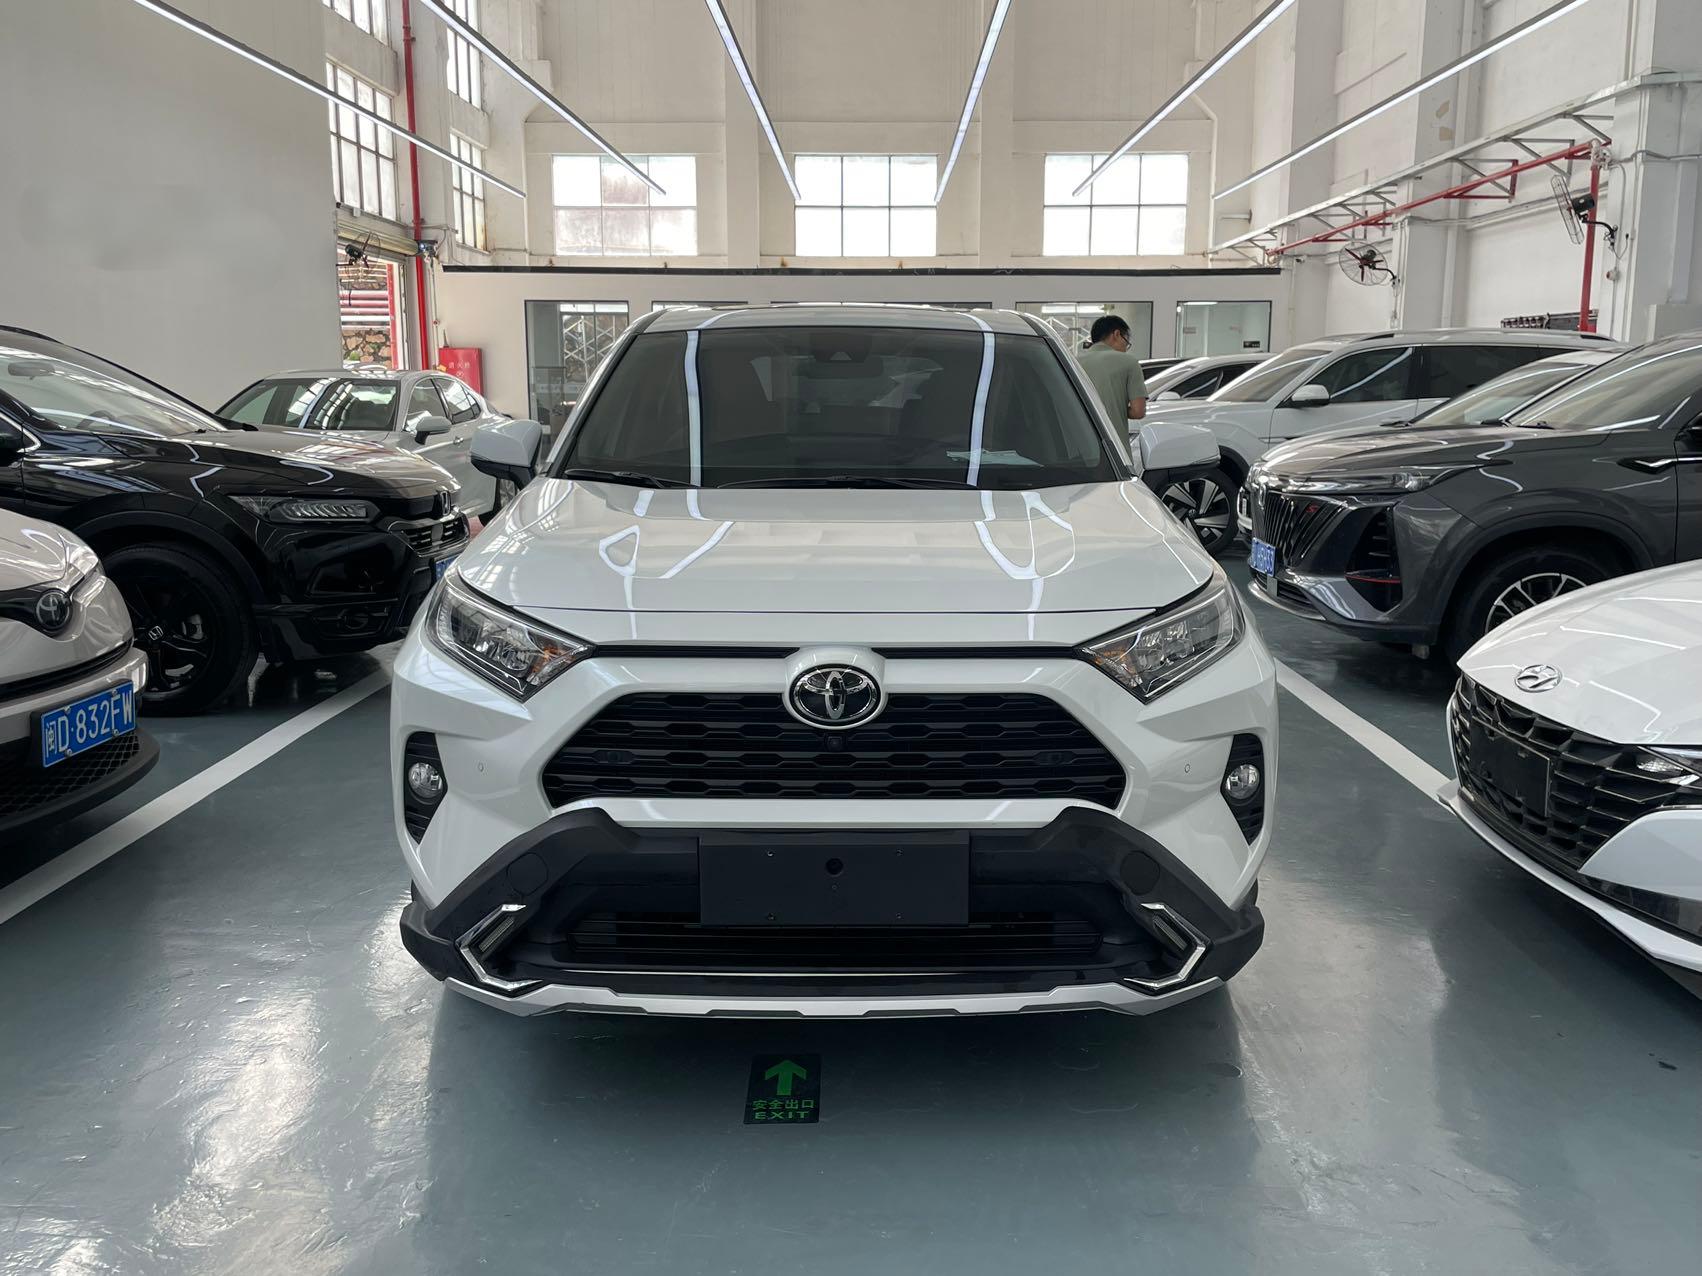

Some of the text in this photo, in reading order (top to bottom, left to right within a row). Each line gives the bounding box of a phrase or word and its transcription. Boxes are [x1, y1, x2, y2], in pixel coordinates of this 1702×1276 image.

[752, 1099, 815, 1110] 安全出口
[754, 1111, 809, 1120] EXIT
